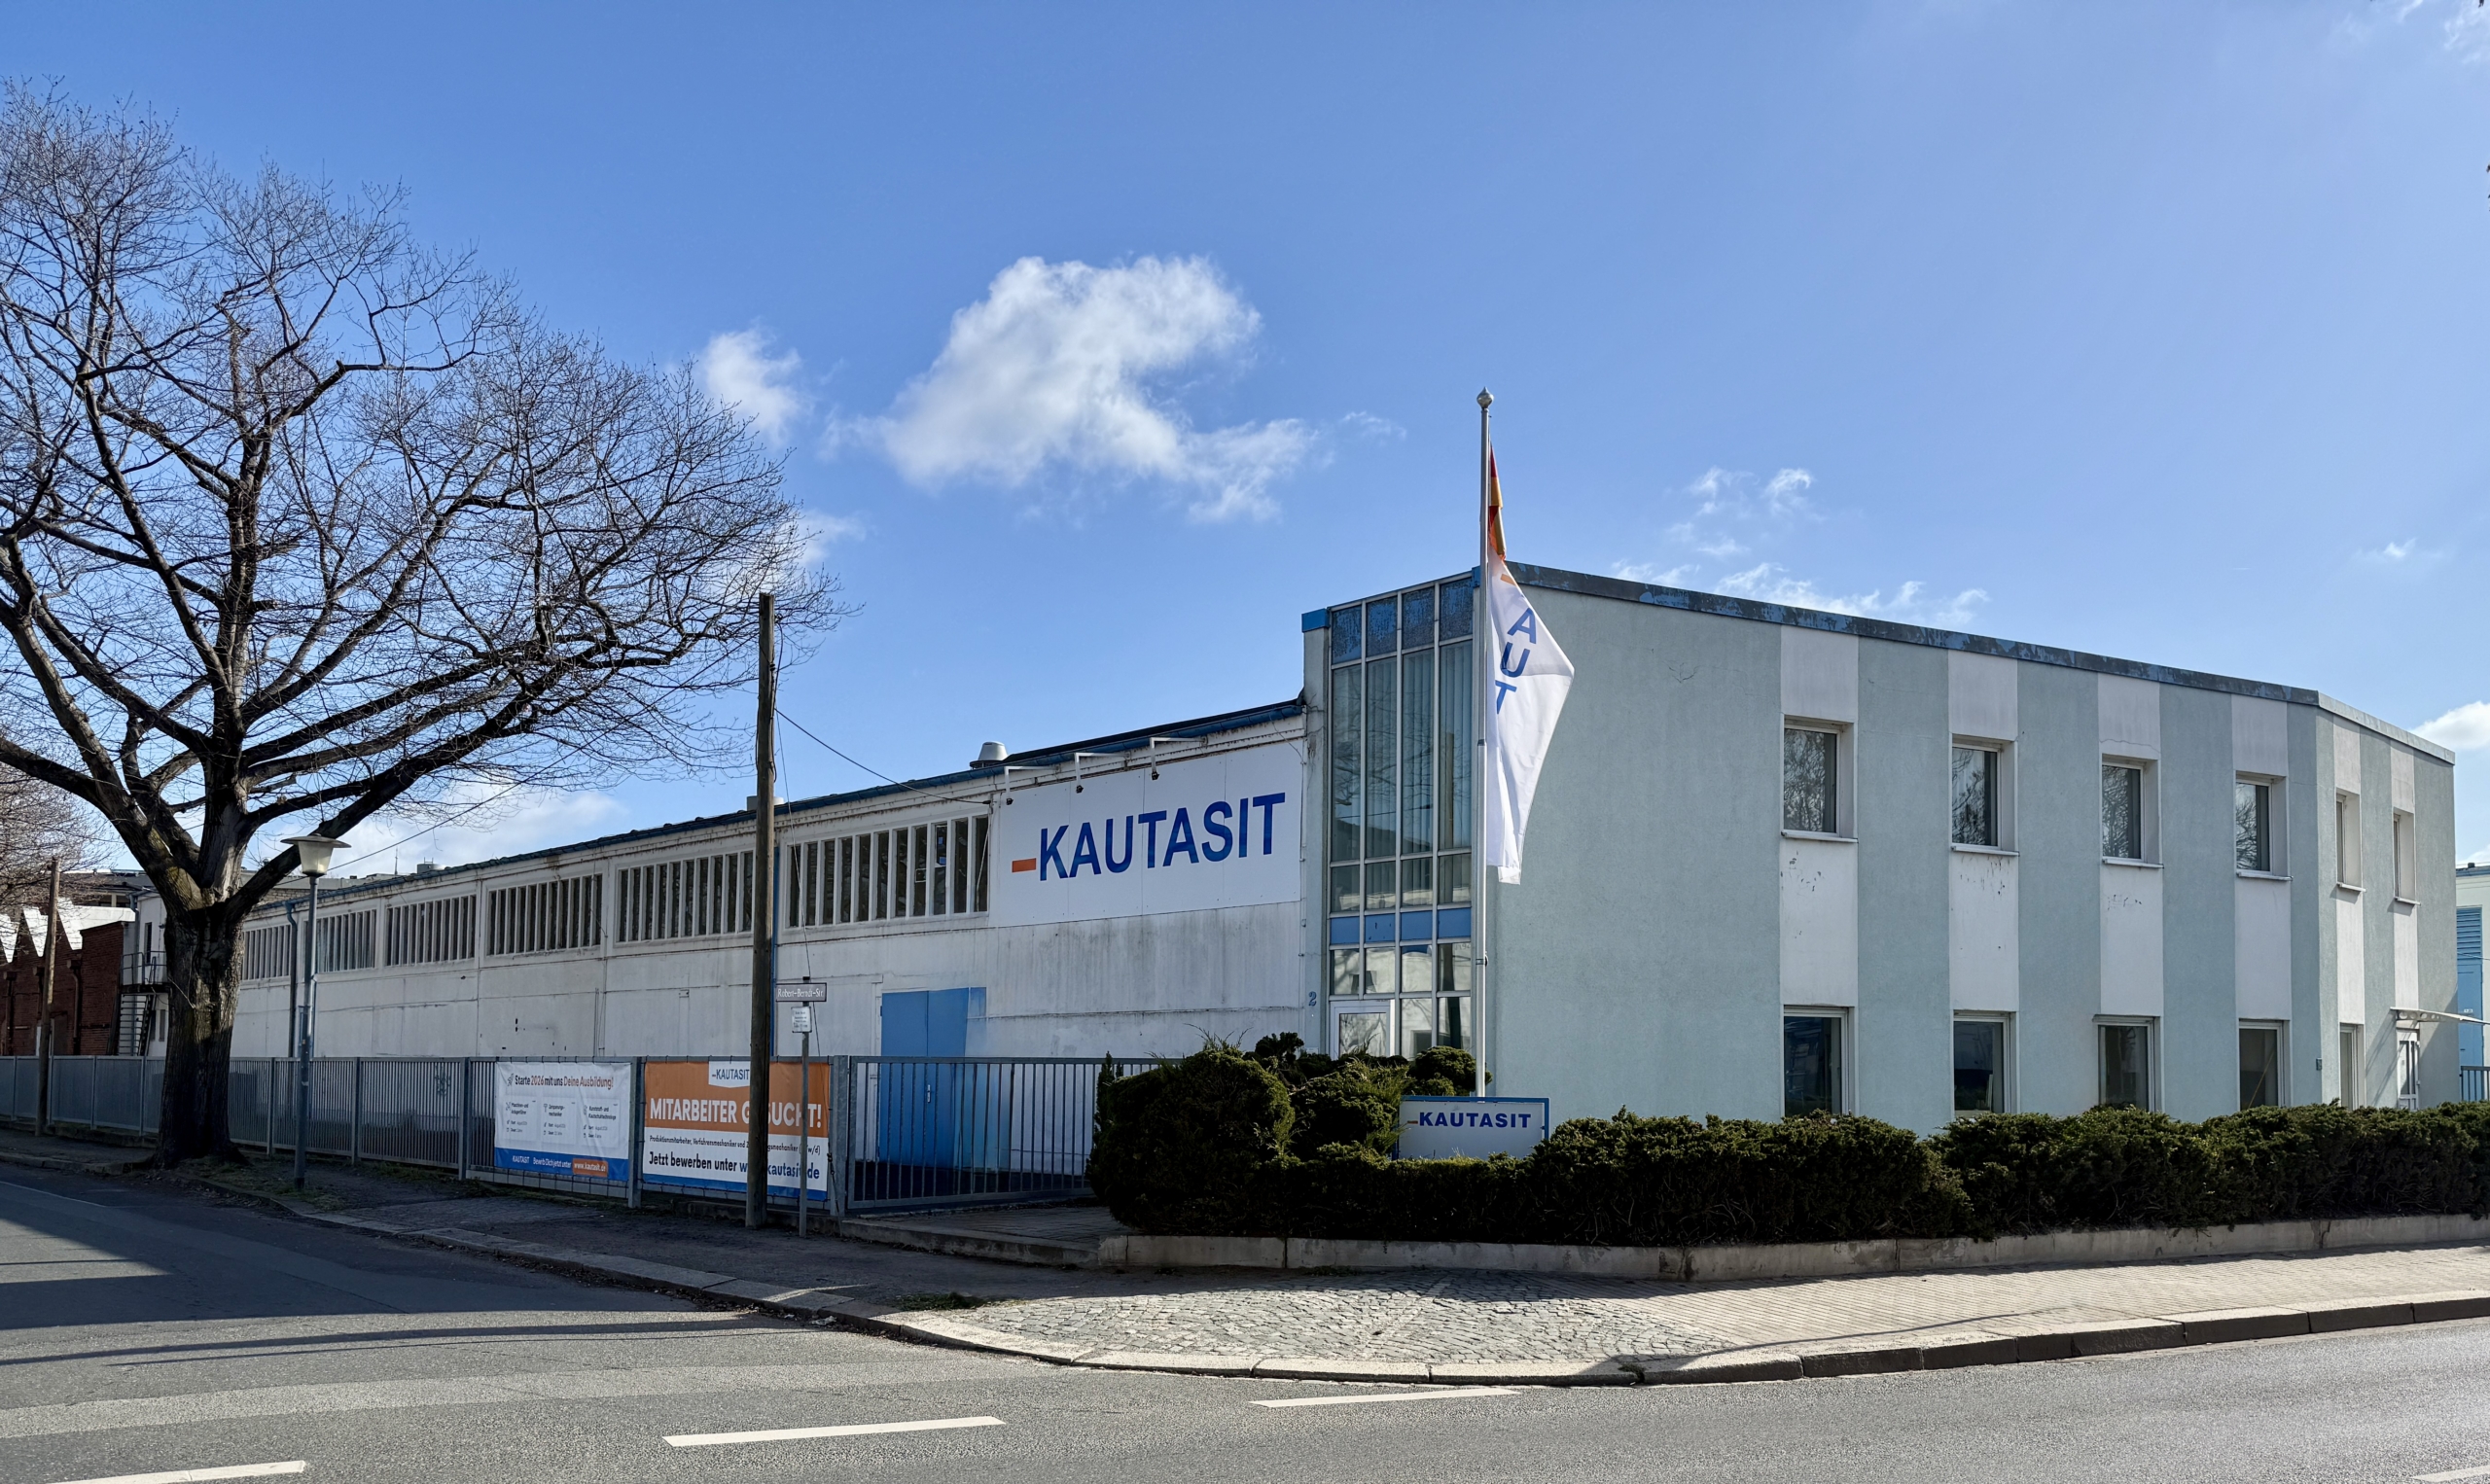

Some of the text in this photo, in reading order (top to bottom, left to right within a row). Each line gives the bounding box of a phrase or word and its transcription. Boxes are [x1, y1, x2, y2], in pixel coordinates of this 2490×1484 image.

[1040, 793, 1285, 881] KAUTASIT
[1308, 991, 1317, 1007] 2
[515, 1075, 531, 1085] Starte
[531, 1076, 545, 1085] 2026
[553, 1078, 563, 1086] uns
[564, 1077, 580, 1086] Deine
[580, 1077, 614, 1090] Ausbildung!
[650, 1098, 737, 1123] MITARBEITER
[1419, 1112, 1532, 1129] KAUTASIT
[649, 1151, 669, 1166] Jetzt
[670, 1151, 712, 1170] bewerben
[714, 1157, 737, 1172] unter
